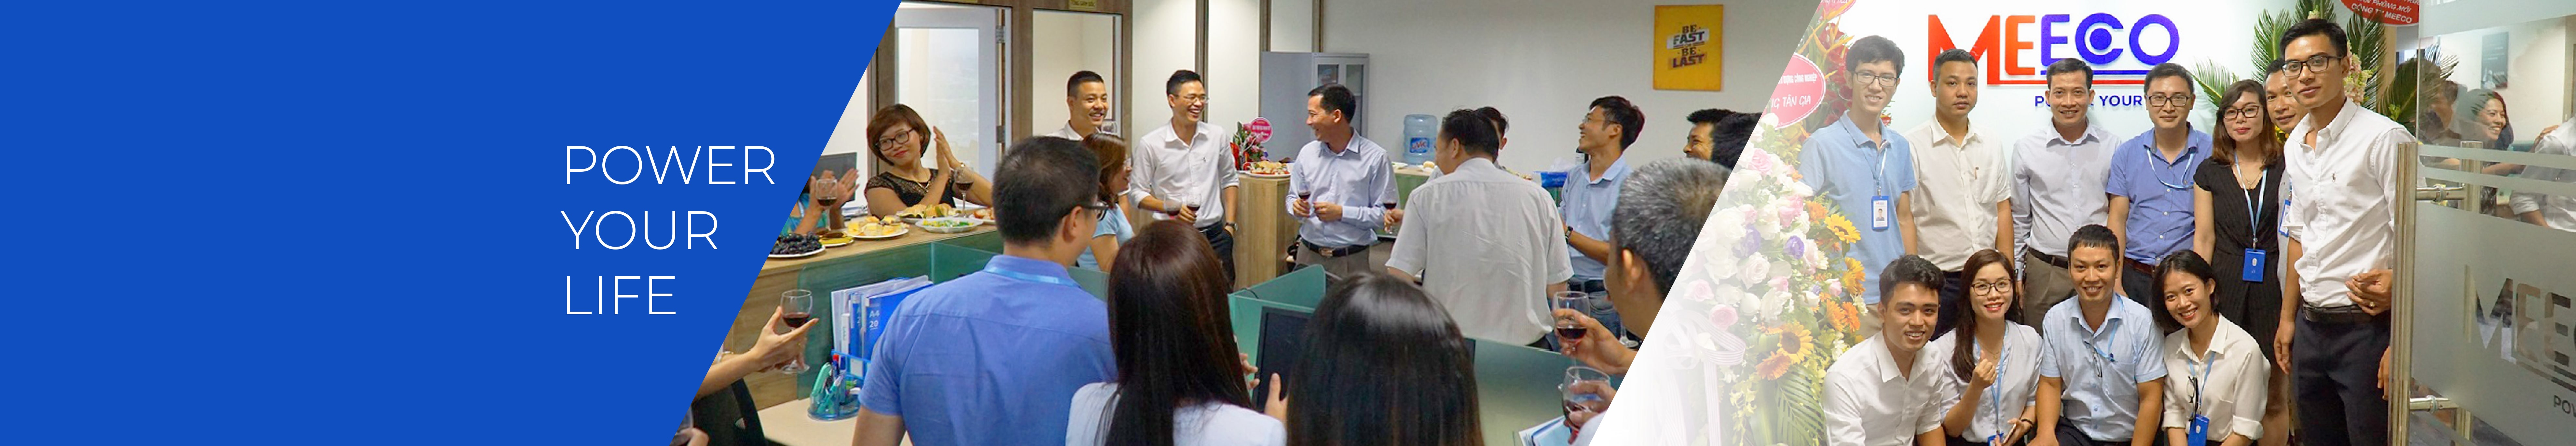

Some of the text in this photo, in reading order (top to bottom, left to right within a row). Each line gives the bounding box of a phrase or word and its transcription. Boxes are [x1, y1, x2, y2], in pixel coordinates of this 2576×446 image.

[2385, 11, 2412, 23] MEECO
[1682, 24, 1697, 34] BE
[1673, 31, 1705, 45] FAST
[1682, 47, 1696, 56] BE
[1928, 13, 2180, 85] MEECO
[1673, 53, 1705, 68] LAST
[1782, 94, 1797, 107] TÂN
[1799, 94, 1811, 106] GIA
[2099, 95, 2142, 106] YOUR
